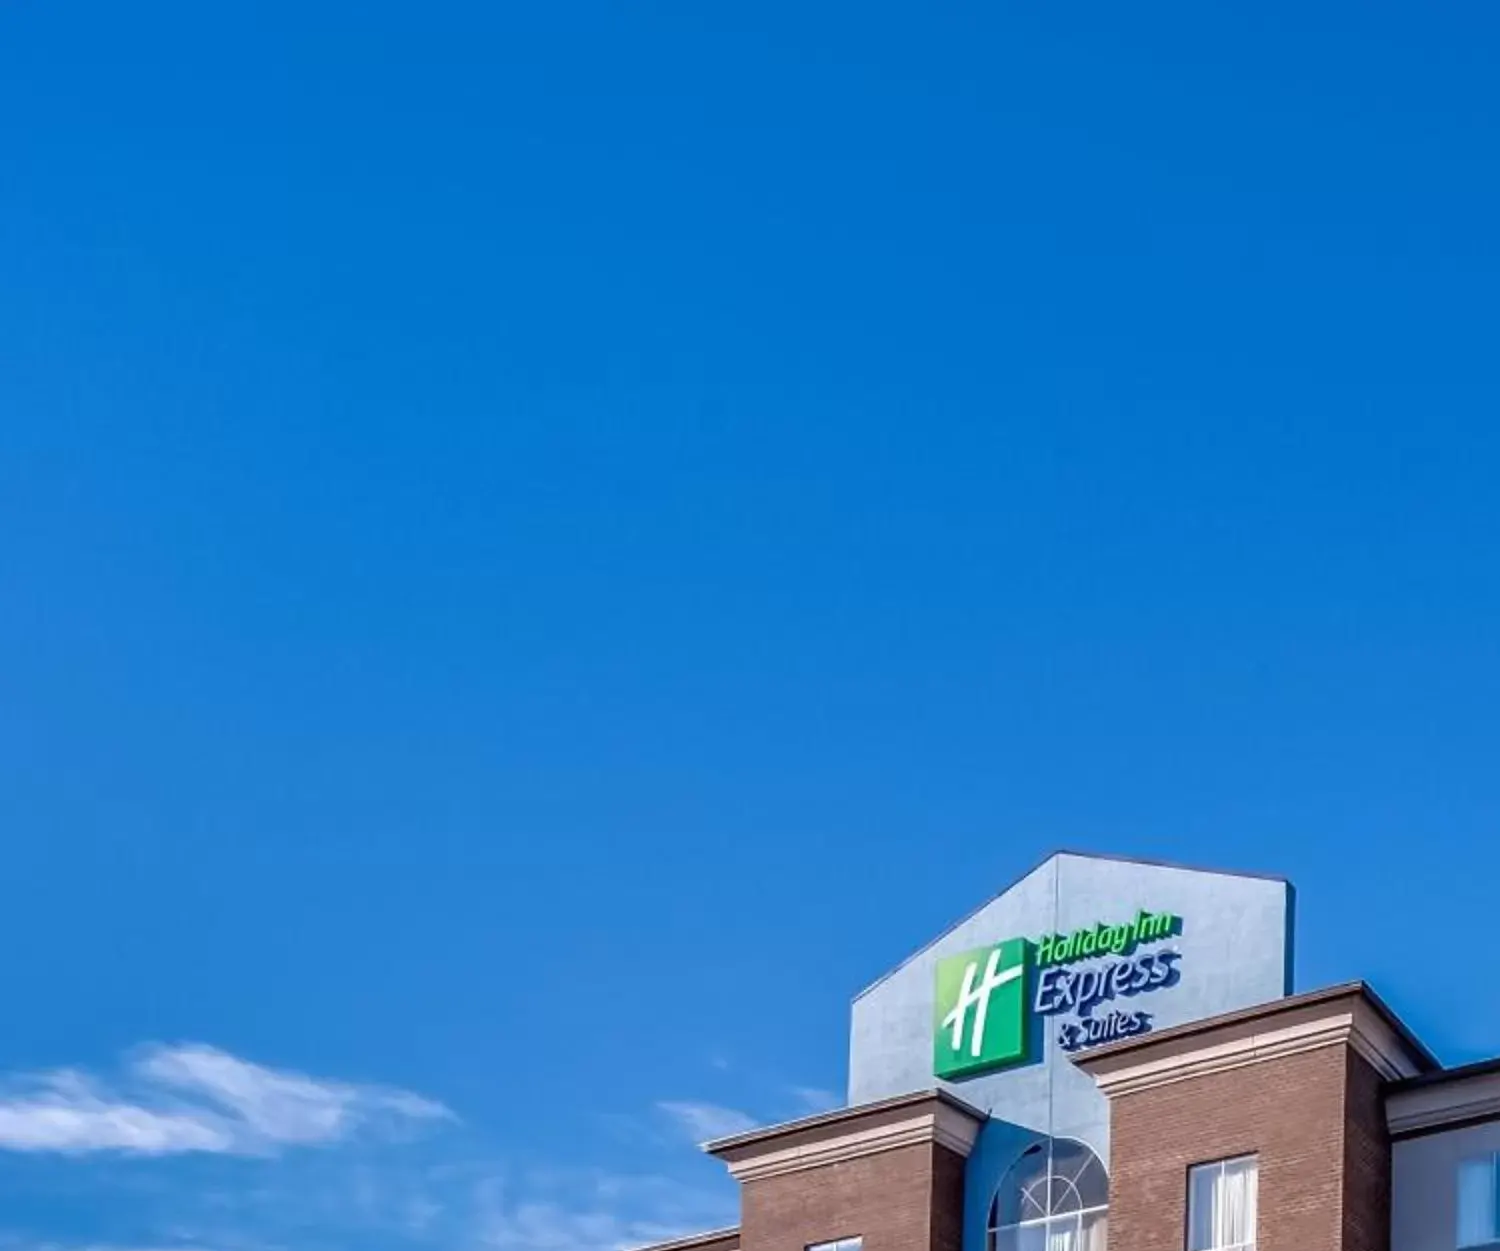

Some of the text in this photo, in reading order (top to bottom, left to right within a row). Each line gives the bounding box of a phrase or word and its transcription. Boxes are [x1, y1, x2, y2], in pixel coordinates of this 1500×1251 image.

[1036, 909, 1173, 967] Holiday Inn
[1034, 948, 1179, 1017] Express
[1057, 1010, 1147, 1047] & Suites
